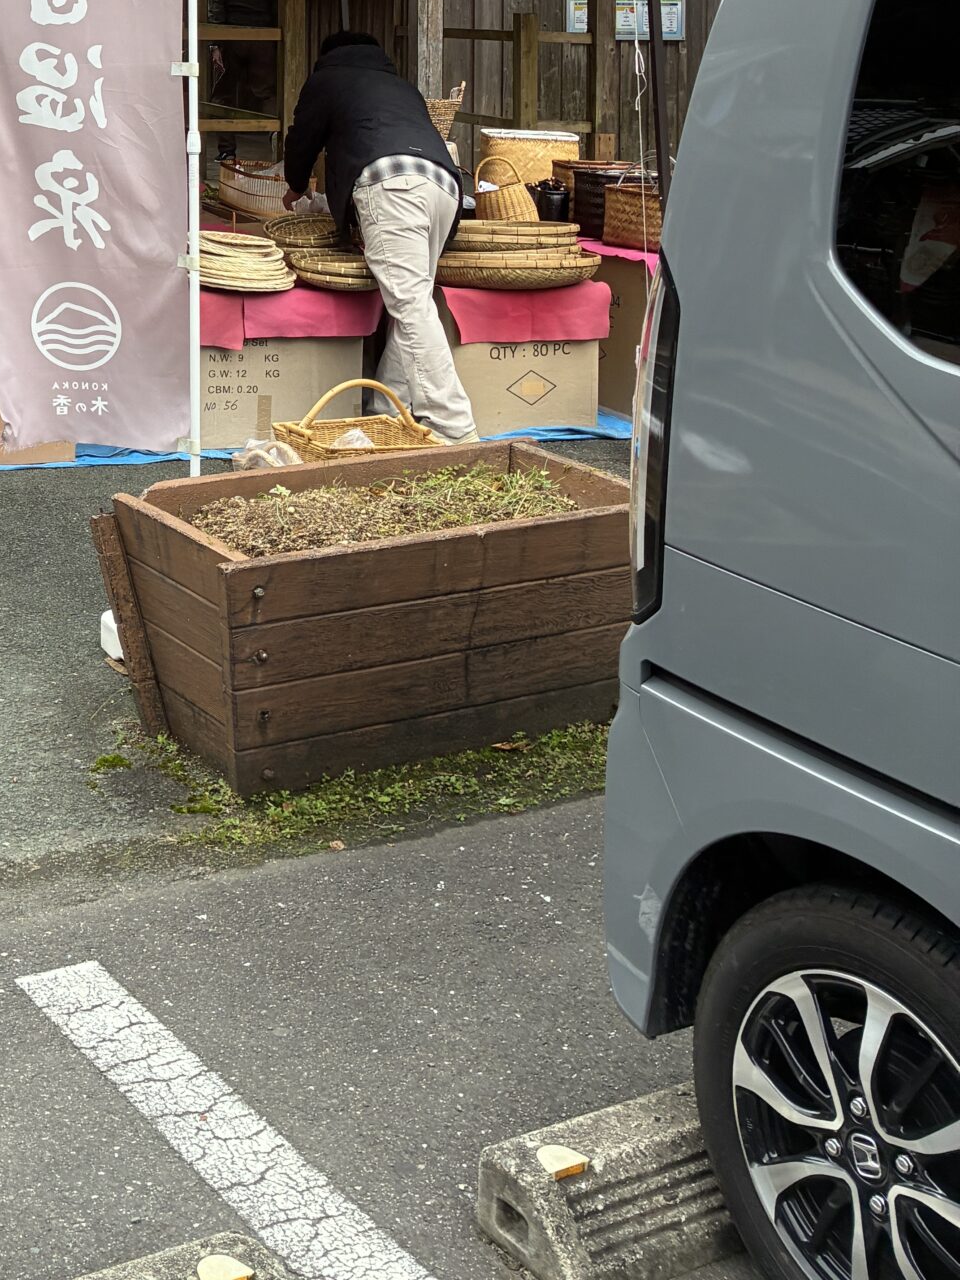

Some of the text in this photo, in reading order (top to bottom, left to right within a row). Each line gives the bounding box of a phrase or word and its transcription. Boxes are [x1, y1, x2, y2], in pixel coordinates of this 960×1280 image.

[489, 345, 518, 361] QTY
[532, 343, 549, 357] 80
[553, 342, 572, 356] PC
[208, 353, 280, 363] N.W: 9 KG
[208, 369, 280, 378] G.W: 12 KG
[207, 385, 259, 394] CBM: 0.20
[223, 399, 239, 411] 56
